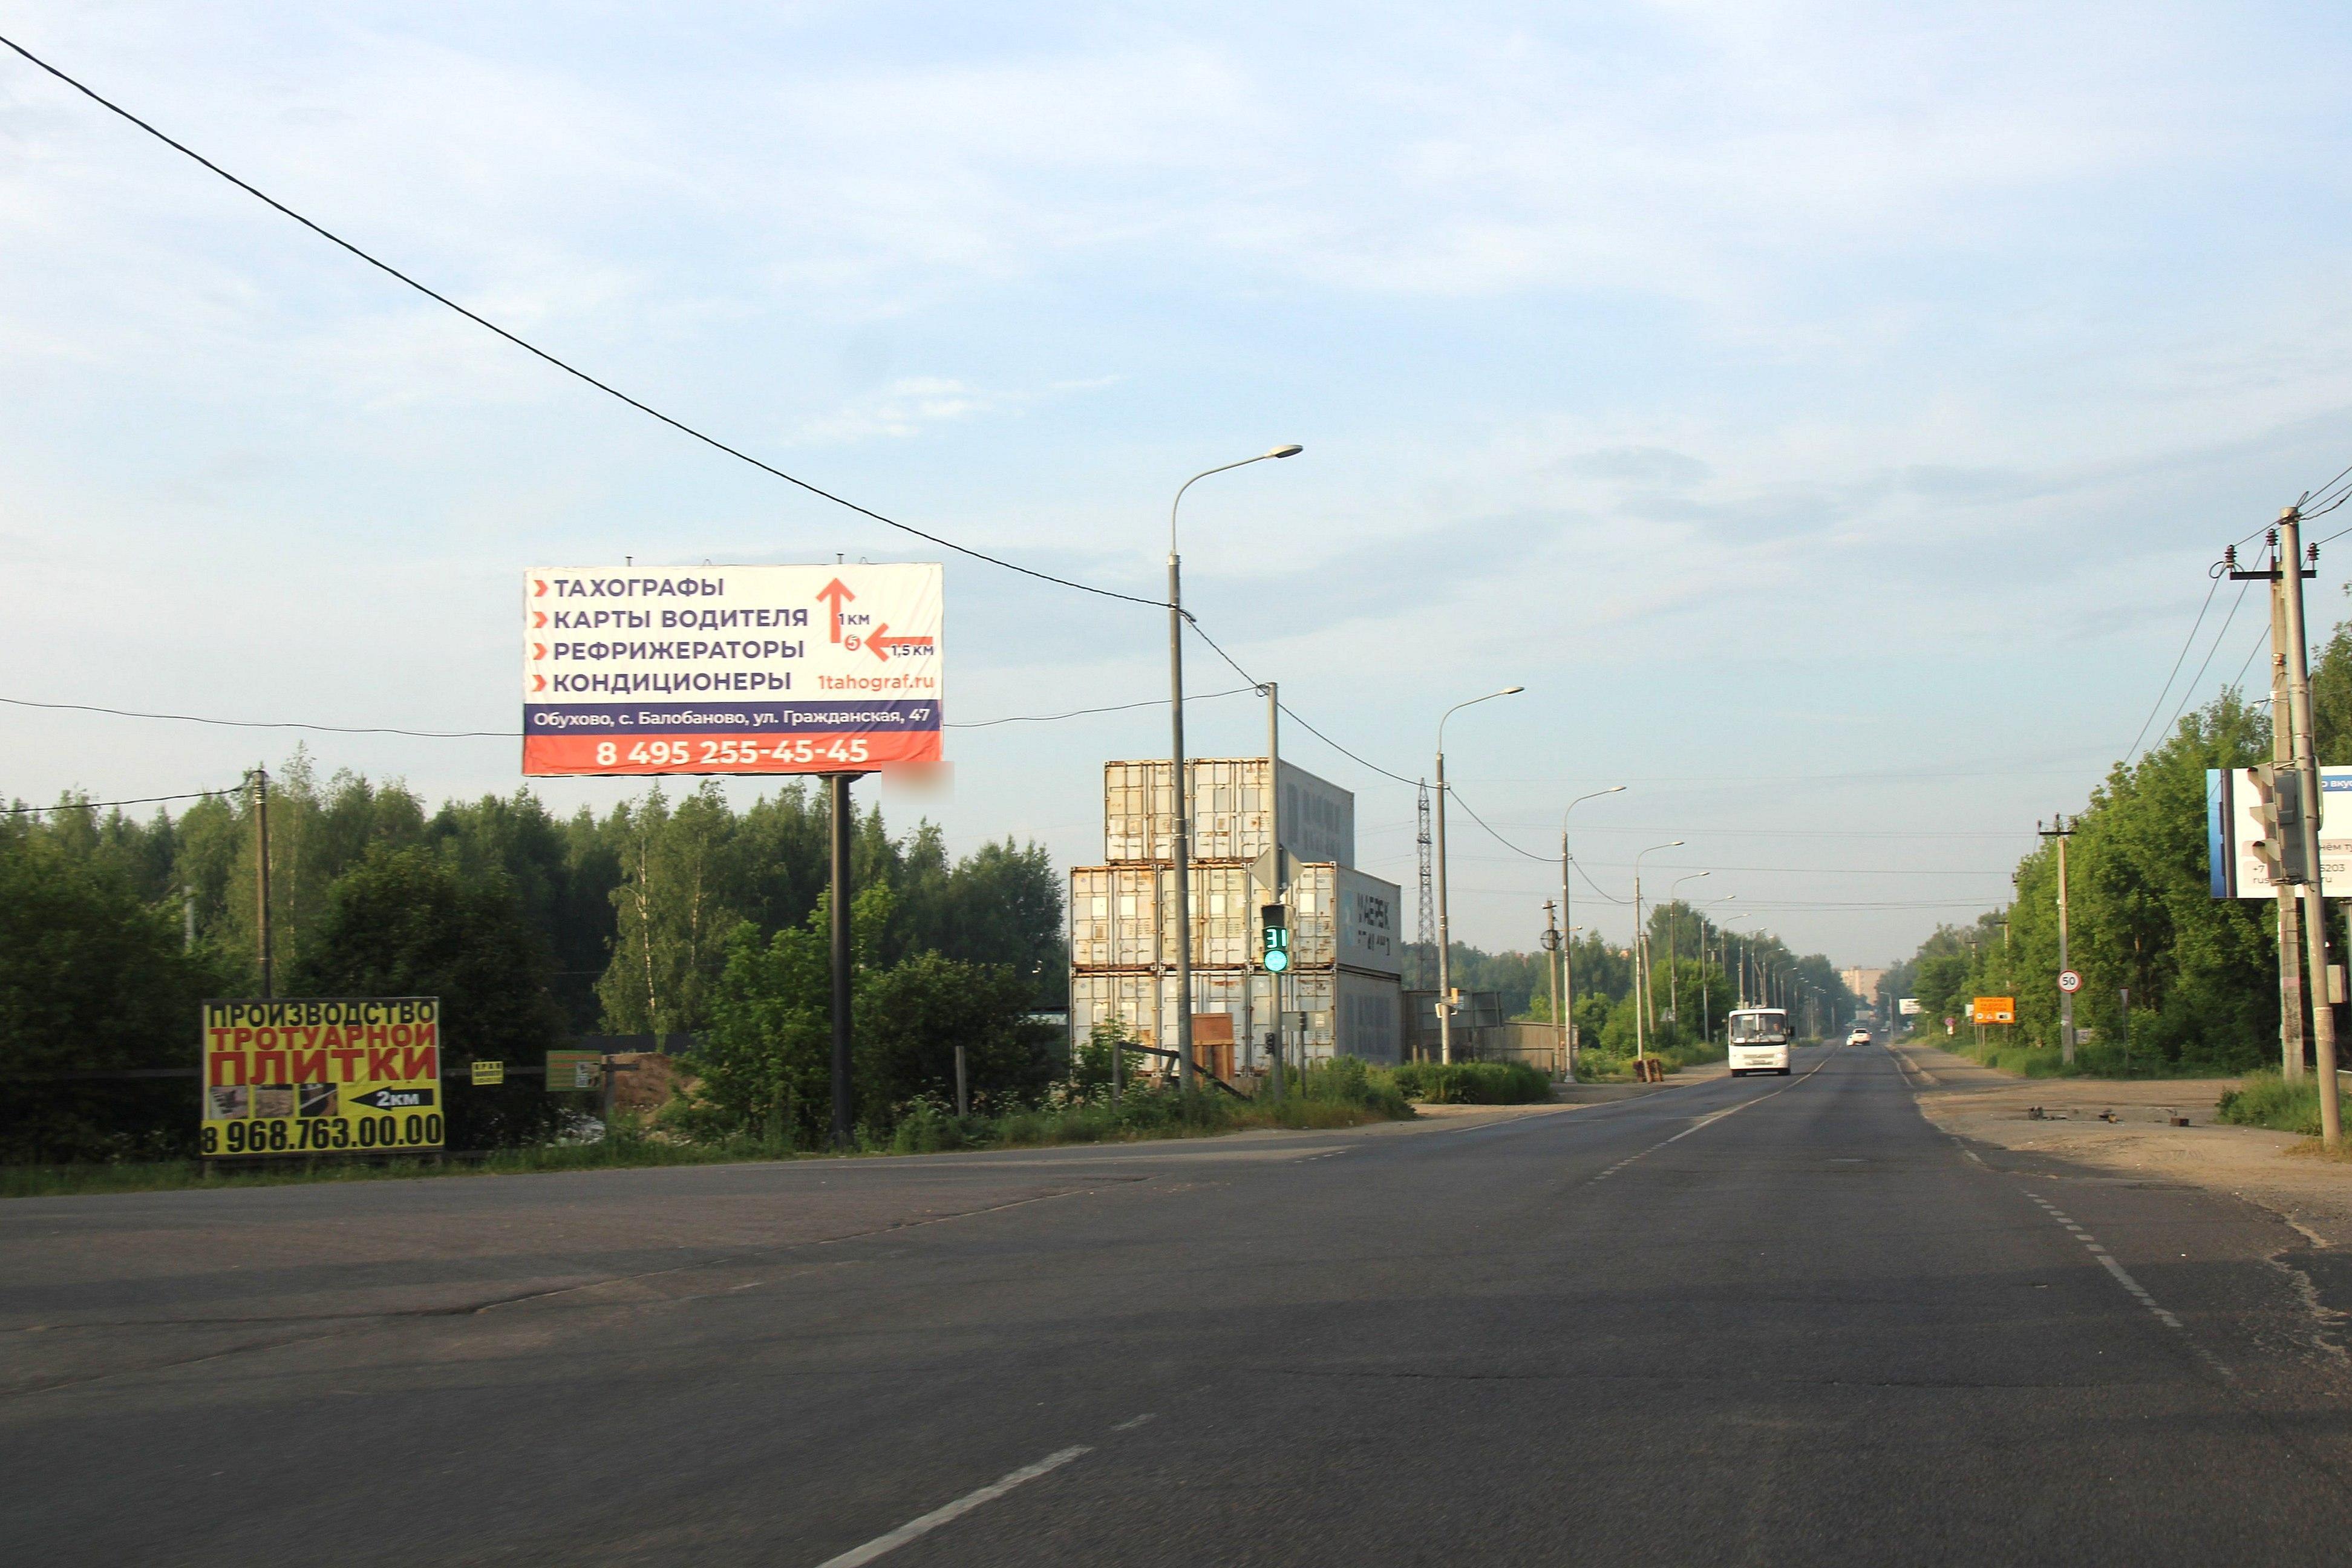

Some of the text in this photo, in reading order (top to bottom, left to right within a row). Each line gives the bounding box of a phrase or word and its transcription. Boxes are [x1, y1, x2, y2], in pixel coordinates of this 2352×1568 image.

[554, 578, 724, 596] ТАХОГРАФЫ
[554, 609, 808, 630] КАРТЫ ВОДИТЕЛЯ
[554, 641, 804, 660] РЕФРИЖЕРАТОРЫ
[554, 672, 791, 694] КОНДИЦИОНЕРЫ
[818, 674, 934, 691] 1tahograf.ru
[534, 708, 930, 728] Обухово, с. Балобаново, ул. Гражданская, 47
[596, 739, 869, 765] 8 495 255-45-45
[1266, 929, 1287, 949] 31
[2063, 977, 2076, 985] 50
[211, 1002, 434, 1027] ПРОИЗВОДСТВО
[211, 1046, 437, 1086] ПЛИТКИ
[227, 1114, 441, 1153] 968.763.00.00
